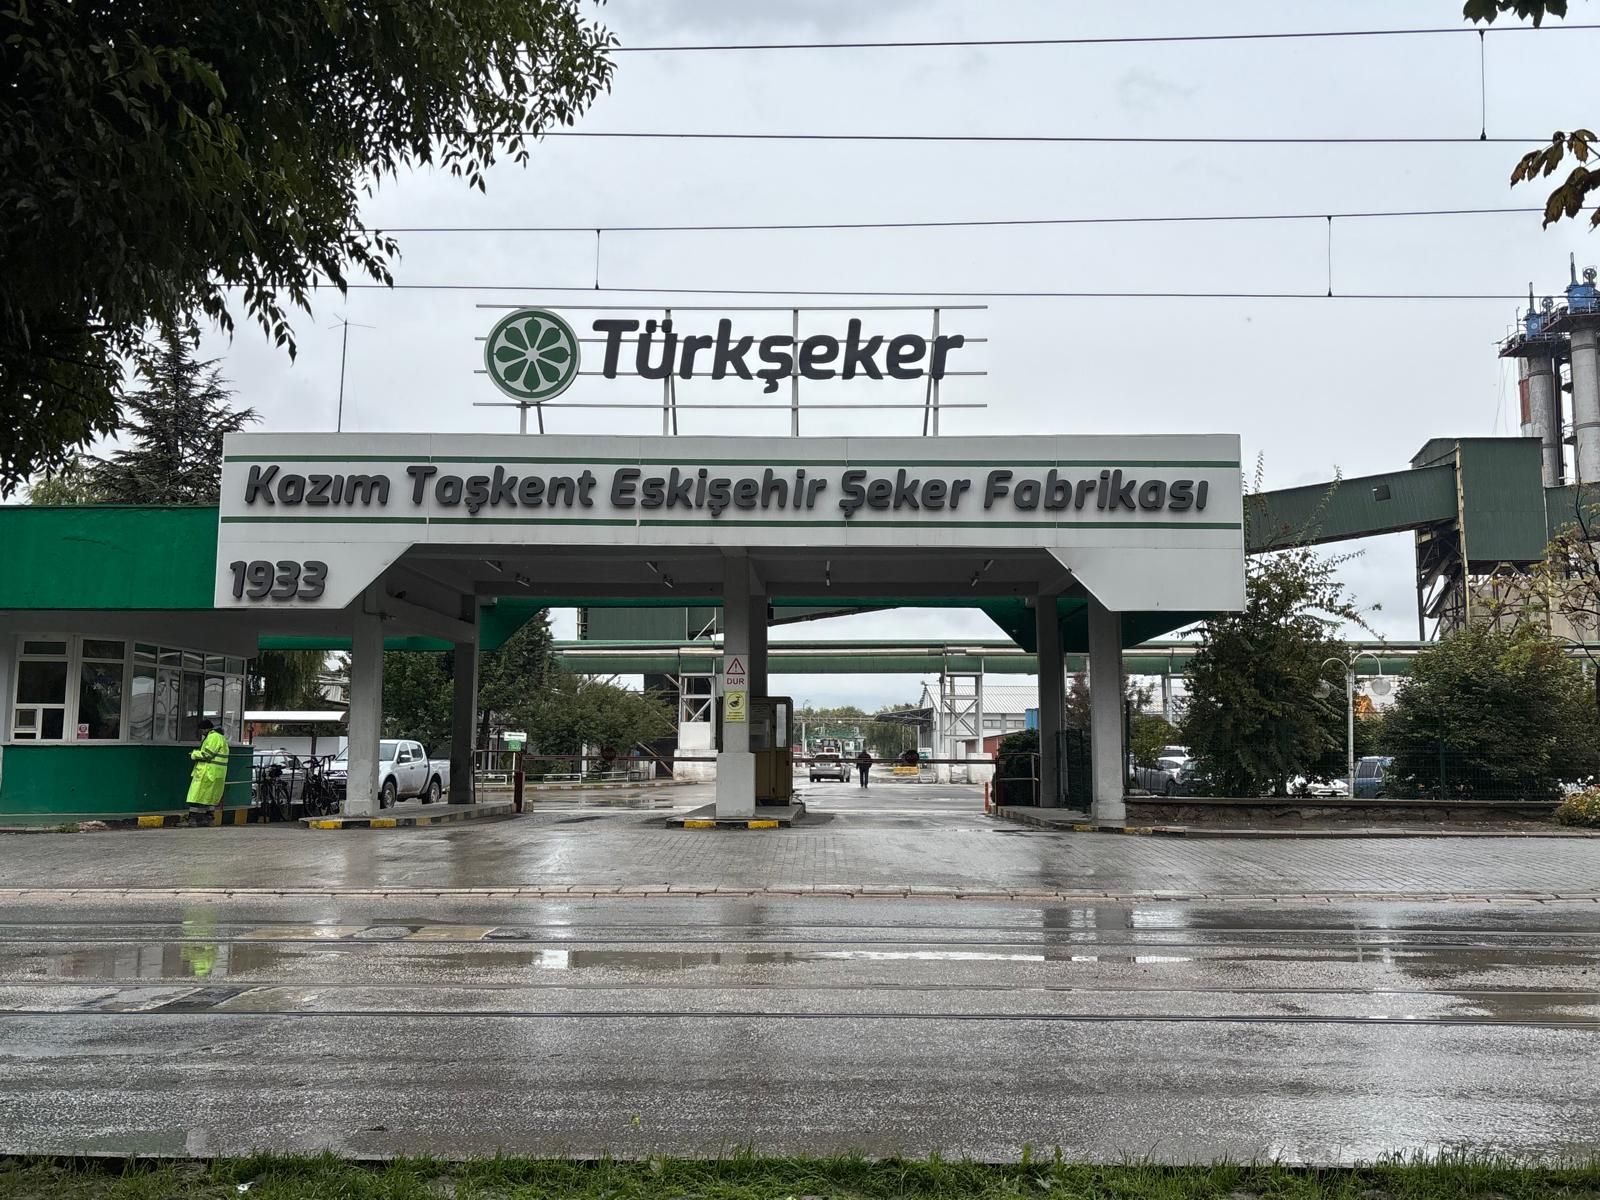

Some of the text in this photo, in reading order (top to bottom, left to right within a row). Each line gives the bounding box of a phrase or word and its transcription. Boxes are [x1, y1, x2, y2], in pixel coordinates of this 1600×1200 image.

[592, 318, 964, 393] Türkşeker
[245, 464, 1209, 519] Kazım Taşkent Eskişehir Şeker Fabrikası
[229, 560, 328, 603] 1933
[726, 677, 745, 685] DUR
